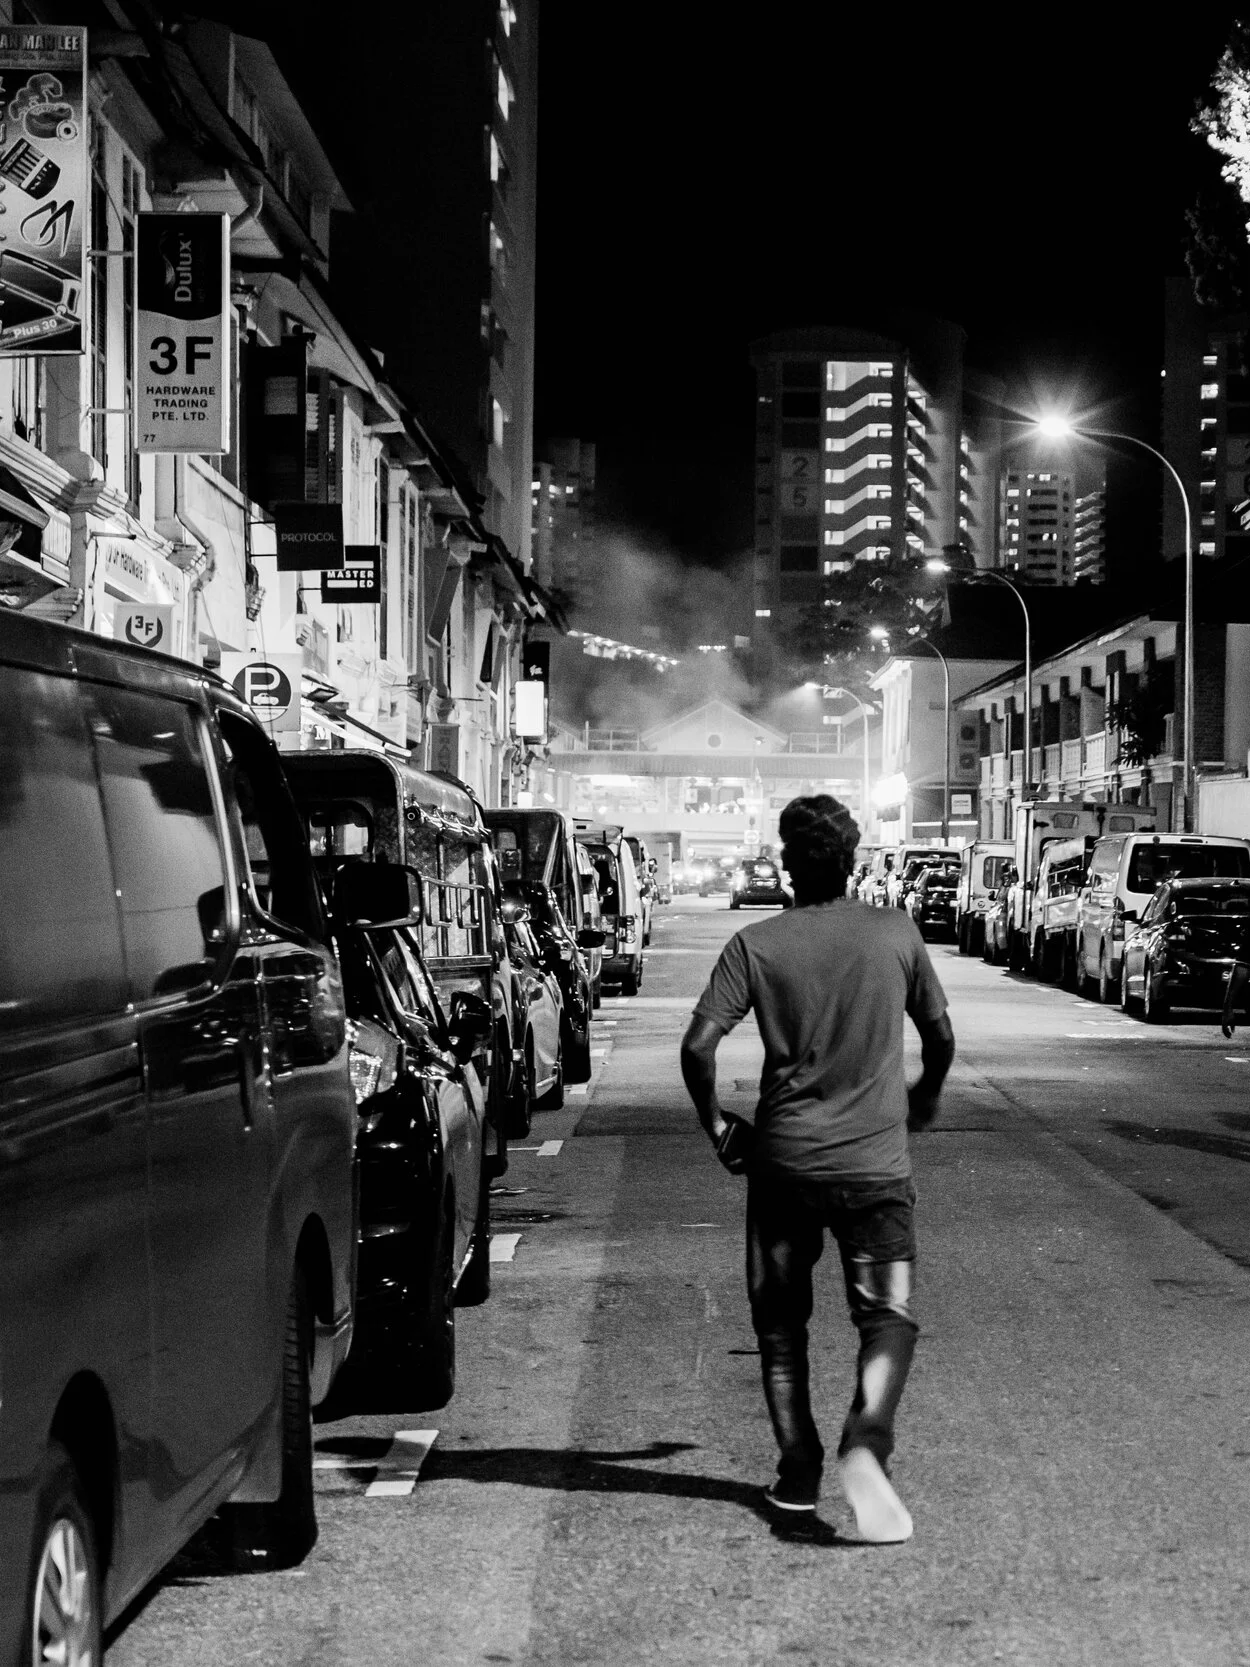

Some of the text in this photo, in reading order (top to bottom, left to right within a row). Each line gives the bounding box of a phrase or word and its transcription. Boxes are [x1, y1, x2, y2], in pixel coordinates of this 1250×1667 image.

[22, 34, 55, 51] MAN
[57, 35, 79, 51] LEE
[175, 238, 193, 302] Dulux
[13, 319, 57, 338] Plus 30
[149, 336, 214, 375] 3F
[146, 386, 215, 395] HARDWARE
[153, 399, 208, 408] TRADING
[152, 411, 209, 421] PTE. LTD.
[143, 434, 156, 443] 77
[280, 532, 338, 543] PROTOCOL
[326, 570, 374, 579] MASTER
[358, 580, 374, 588] ED
[134, 615, 154, 636] 3F
[245, 667, 281, 705] P
